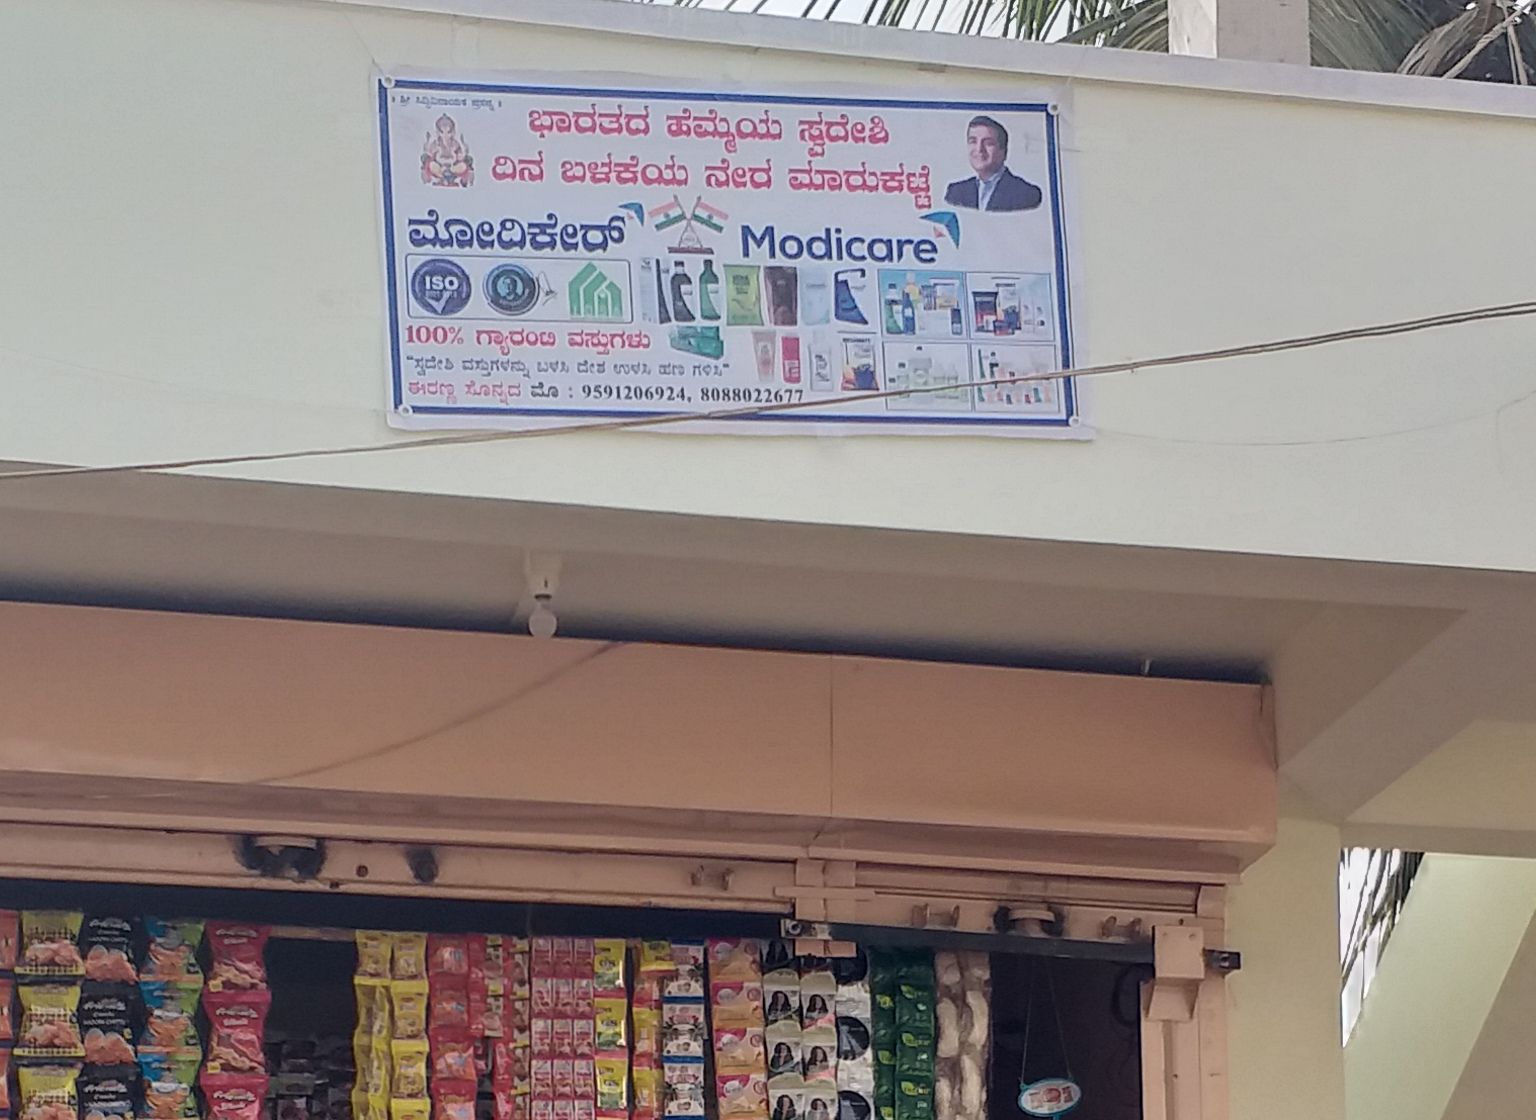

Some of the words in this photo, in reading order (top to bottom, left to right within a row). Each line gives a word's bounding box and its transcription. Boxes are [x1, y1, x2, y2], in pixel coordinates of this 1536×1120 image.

[528, 103, 650, 138] ಭಾರತದ
[666, 107, 782, 154] ಹೆಮ್ಮೆಯ
[798, 112, 889, 157] ಸ್ವದೇಶಿ
[491, 150, 544, 183] ದಿನ
[561, 152, 689, 187] ಬಳಕೆಯ
[704, 158, 773, 189] ನೇರ
[788, 160, 932, 210] ಮಾರುಕಟ್ಟೆ
[407, 209, 626, 254] ಮೋದಿಕೇರ್
[740, 224, 938, 263] Modicare
[425, 275, 459, 290] ISO
[406, 325, 464, 346] 100%
[476, 328, 556, 356] ಗ್ಯಾರಂಟಿ
[568, 330, 651, 355] ವಸ್ತುಗಳು
[582, 385, 692, 402] 9591206924,
[701, 388, 803, 404] 8088022677
